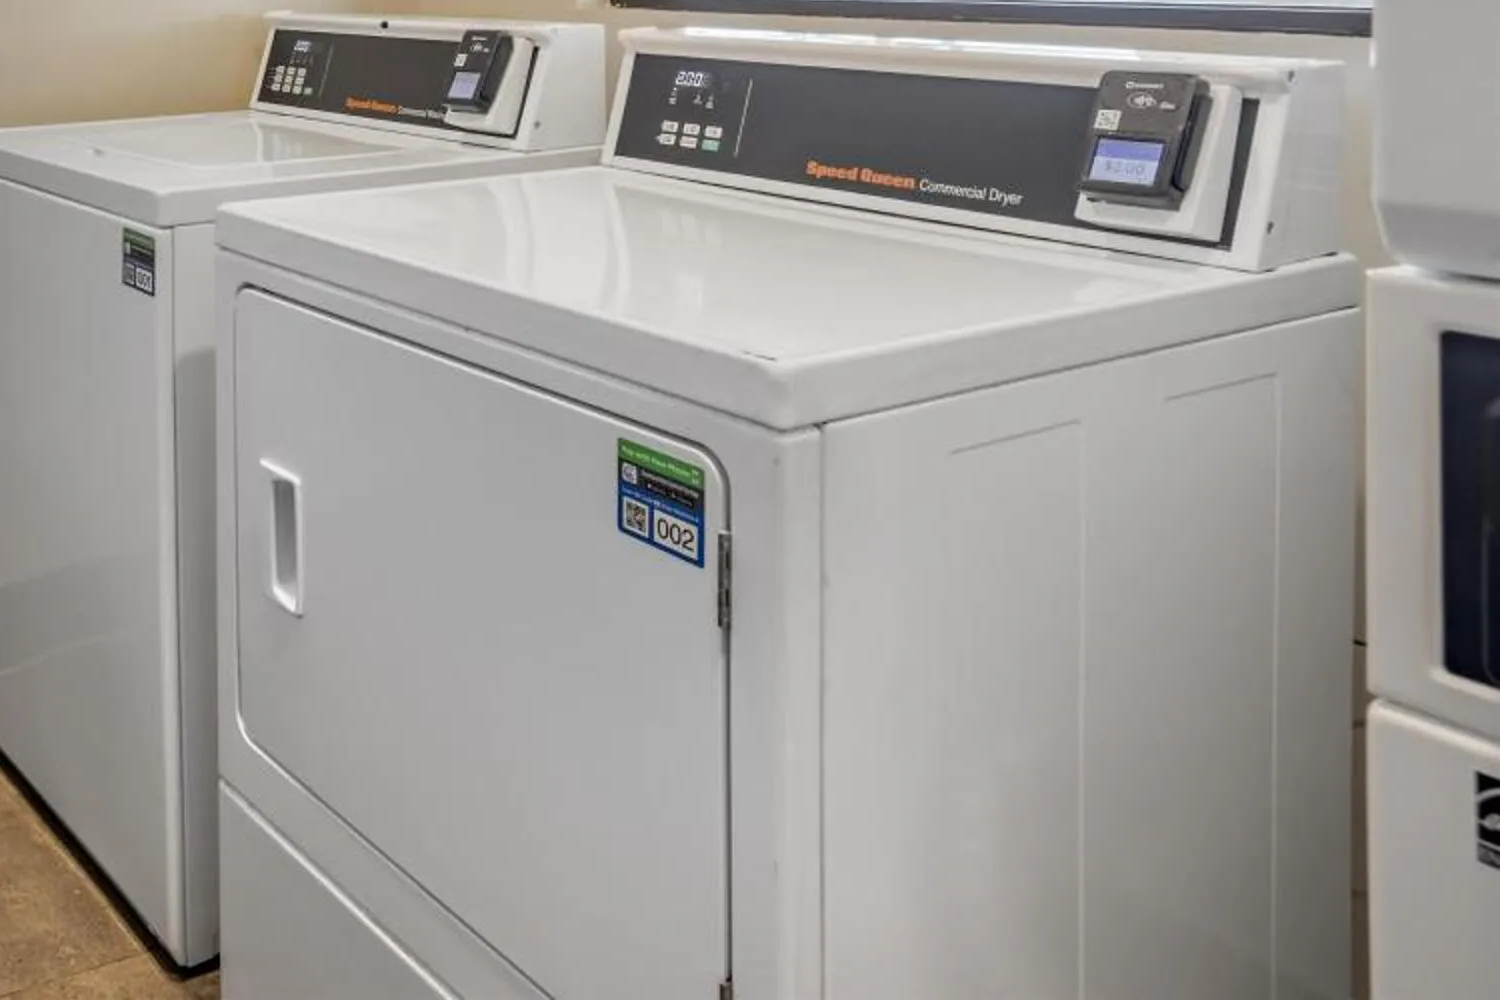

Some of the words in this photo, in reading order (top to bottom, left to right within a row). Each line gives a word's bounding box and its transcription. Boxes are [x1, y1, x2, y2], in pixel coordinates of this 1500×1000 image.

[805, 159, 859, 181] Speed
[860, 168, 916, 190] Queen
[918, 178, 987, 200] Commercial
[988, 187, 1024, 207] Dryer
[657, 518, 695, 553] 002
